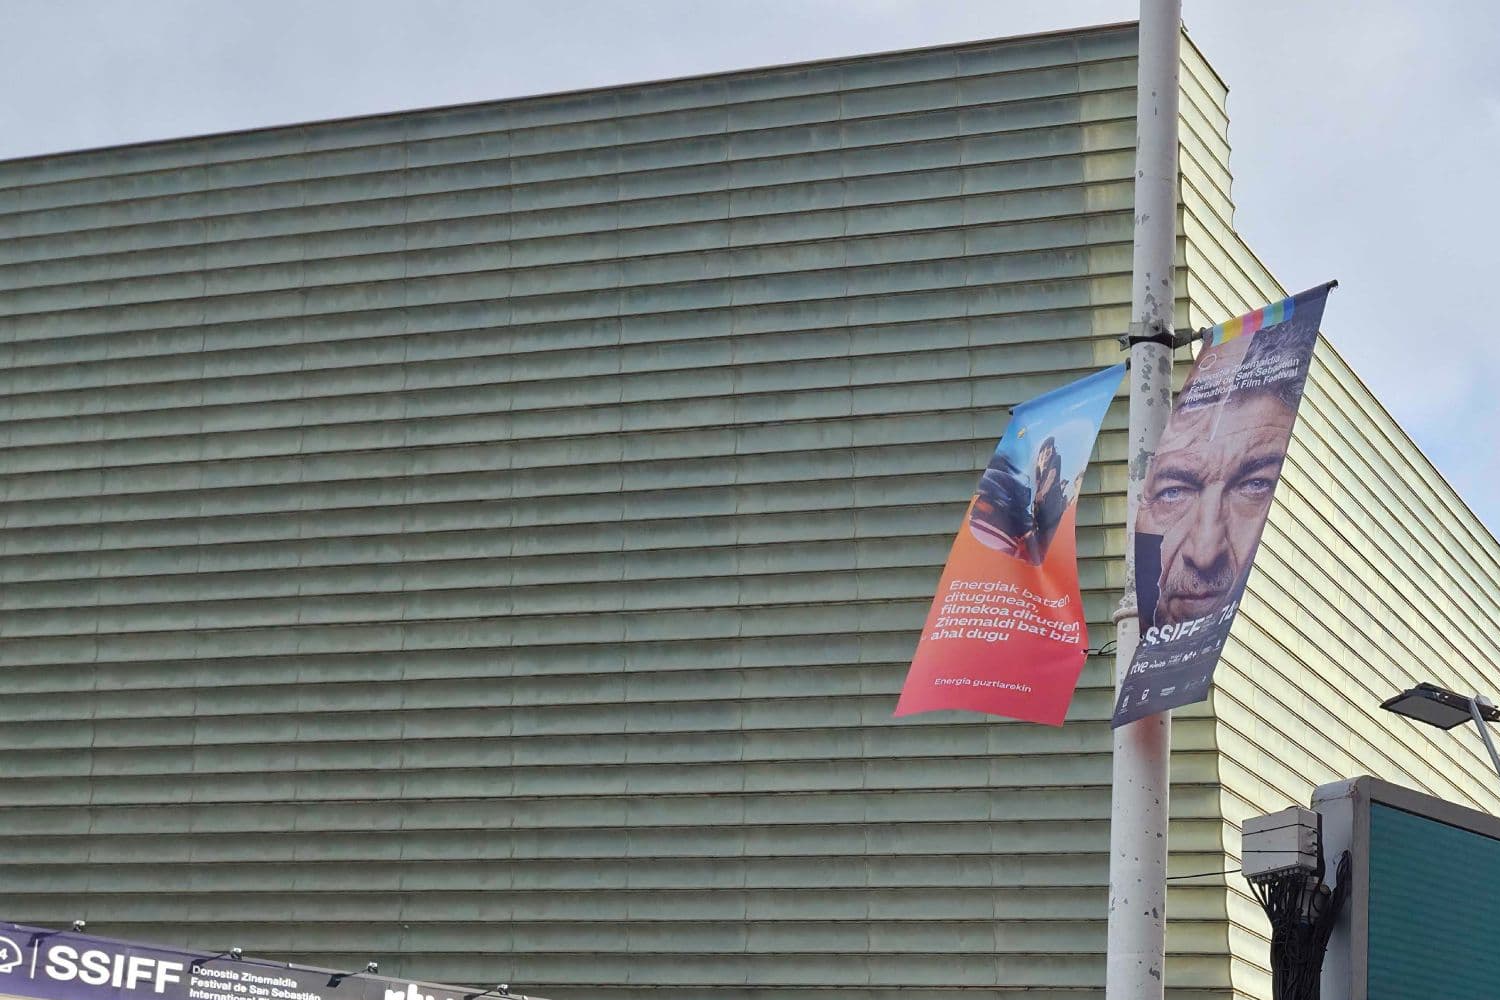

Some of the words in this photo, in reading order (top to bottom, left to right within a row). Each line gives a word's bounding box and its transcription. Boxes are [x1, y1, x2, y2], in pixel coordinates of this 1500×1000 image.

[1236, 372, 1253, 381] San
[1255, 358, 1299, 377] Sebastián
[1241, 378, 1261, 389] Film
[1263, 368, 1299, 385] Festival
[943, 591, 1040, 613] ditugunean,
[949, 580, 1019, 596] Energiak
[1021, 588, 1070, 609] batzen
[941, 604, 1010, 617] filmekoa
[1012, 609, 1080, 632] dirudien
[930, 628, 964, 641] ahal
[965, 628, 1010, 643] dugu
[935, 616, 1016, 629] zinemaldi
[1017, 622, 1046, 635] bat
[1049, 629, 1080, 644] bizi
[1142, 617, 1206, 647] SSIFF
[972, 679, 1032, 693] guztiarekin
[45, 945, 183, 993] SSIFF
[192, 964, 240, 981] Donostia
[240, 971, 298, 988] Zinemaldia
[190, 977, 232, 993] Festival
[233, 982, 248, 993] de
[248, 985, 269, 997] San
